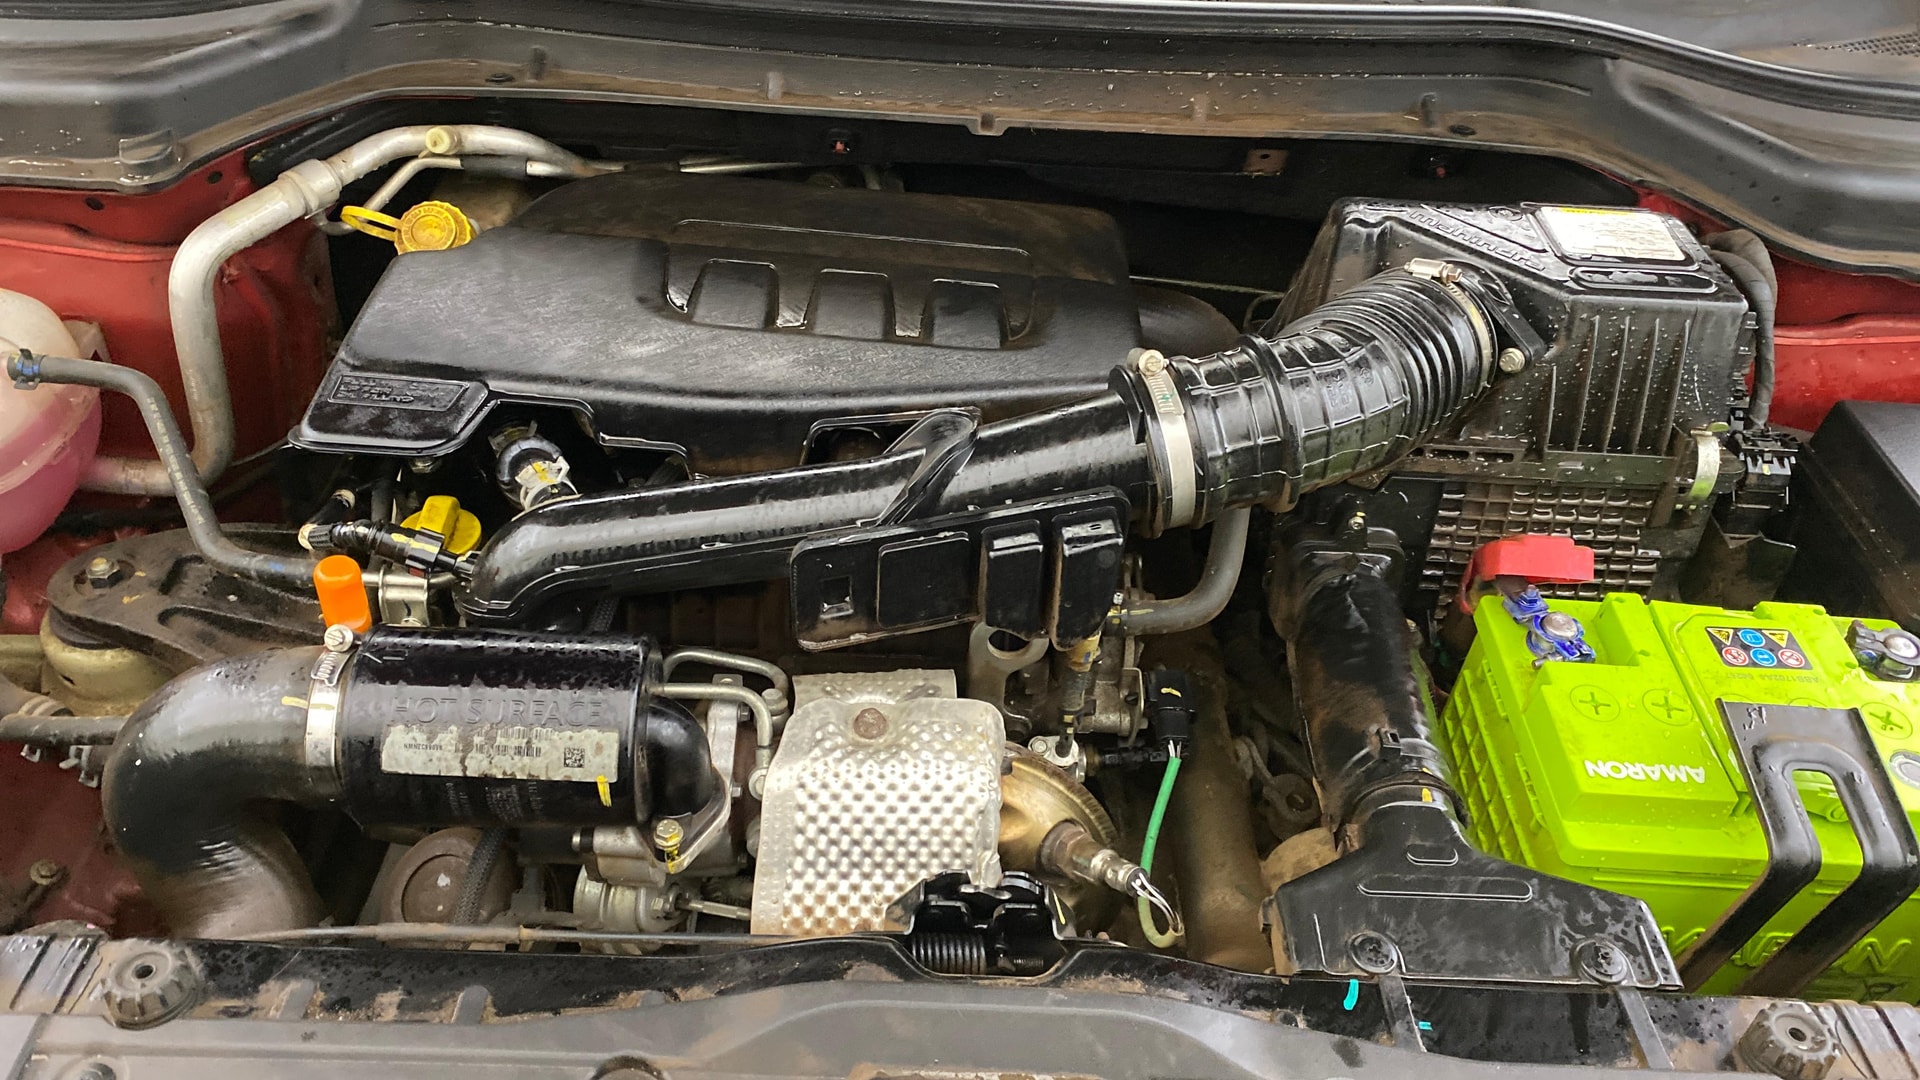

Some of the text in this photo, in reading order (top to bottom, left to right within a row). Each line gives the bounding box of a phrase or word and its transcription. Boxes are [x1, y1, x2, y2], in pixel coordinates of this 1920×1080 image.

[390, 696, 603, 728] HOT SURFACE
[1584, 760, 1706, 784] AMARON
